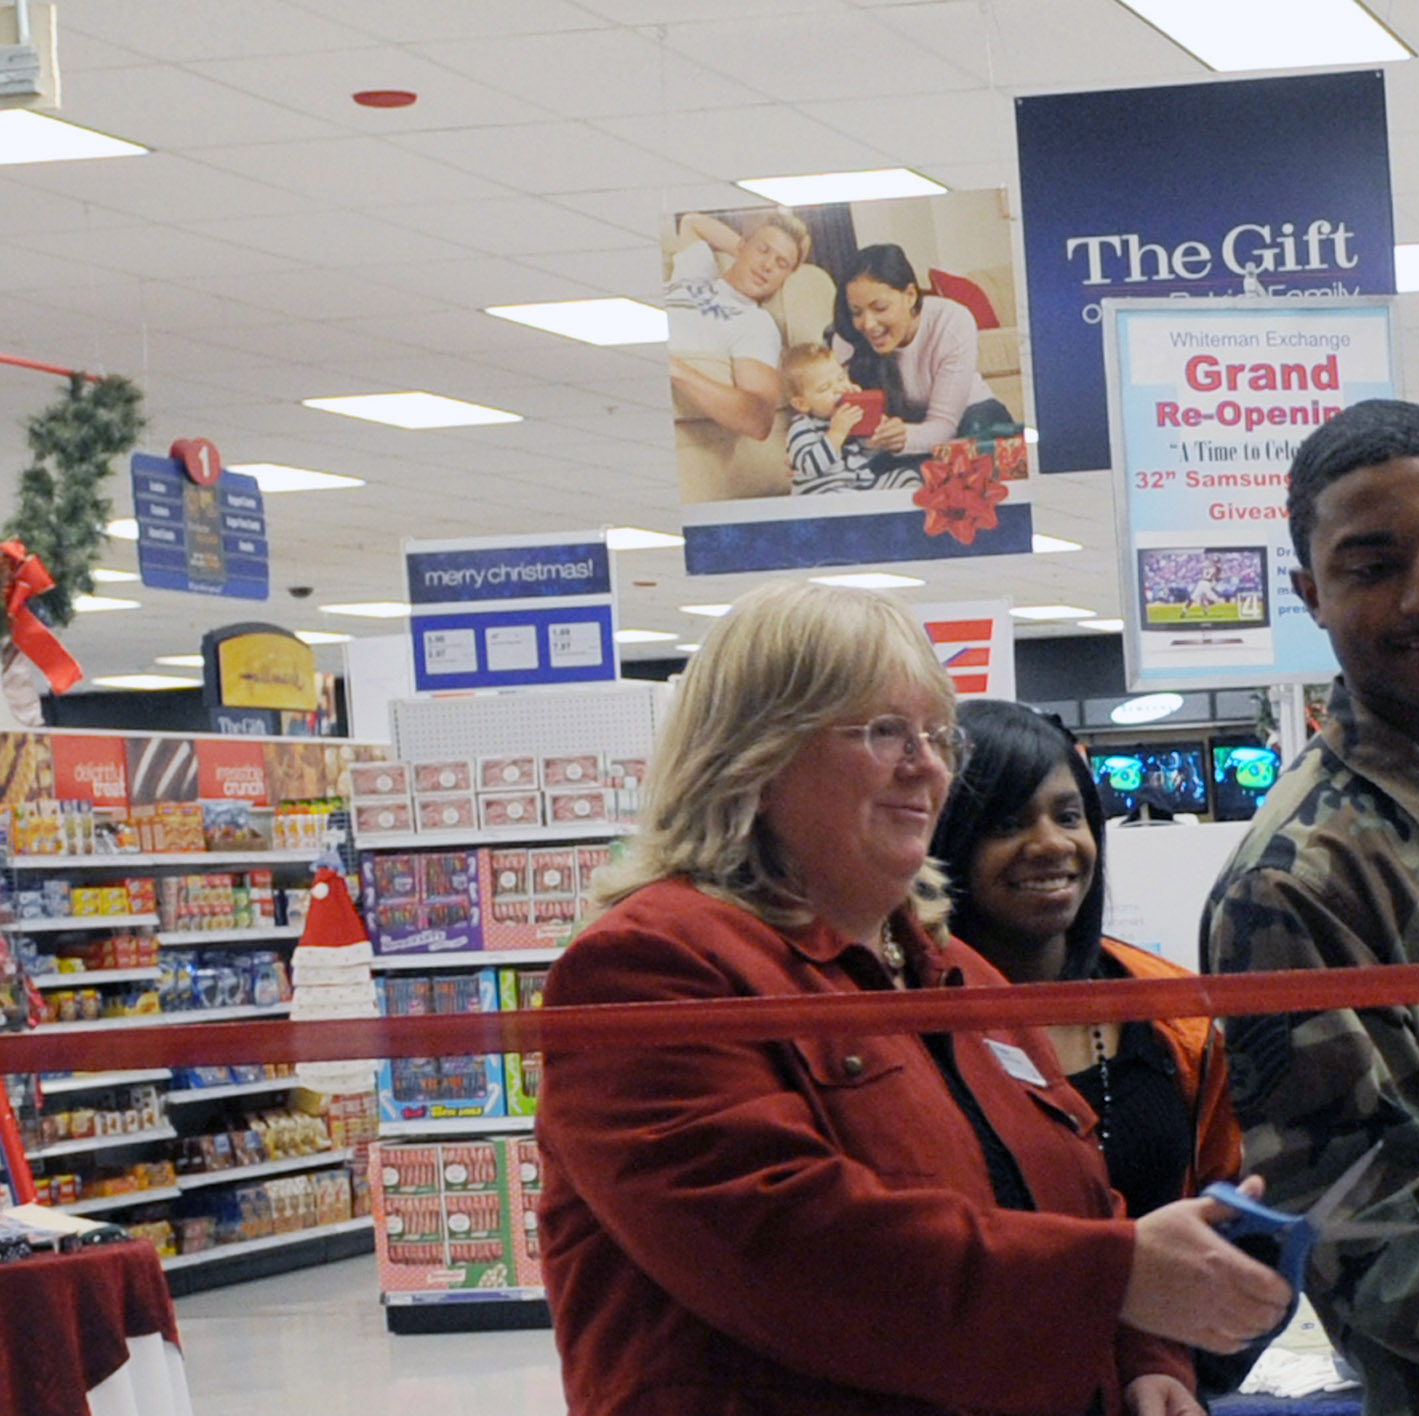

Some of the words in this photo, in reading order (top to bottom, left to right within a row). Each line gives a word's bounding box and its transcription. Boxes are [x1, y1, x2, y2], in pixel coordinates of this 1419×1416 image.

[1066, 233, 1212, 286] The
[1222, 219, 1359, 276] Gift
[1170, 331, 1260, 349] Whiteman
[1266, 331, 1351, 350] Exchange
[1185, 354, 1340, 392] Grand
[1155, 400, 1343, 432] Re-Openin
[199, 445, 211, 478] 1
[1194, 440, 1238, 463] Time
[1244, 442, 1260, 462] to
[1266, 440, 1299, 462] Cele
[424, 568, 484, 588] merry
[487, 558, 594, 583] christmas!
[223, 779, 265, 796] crunch
